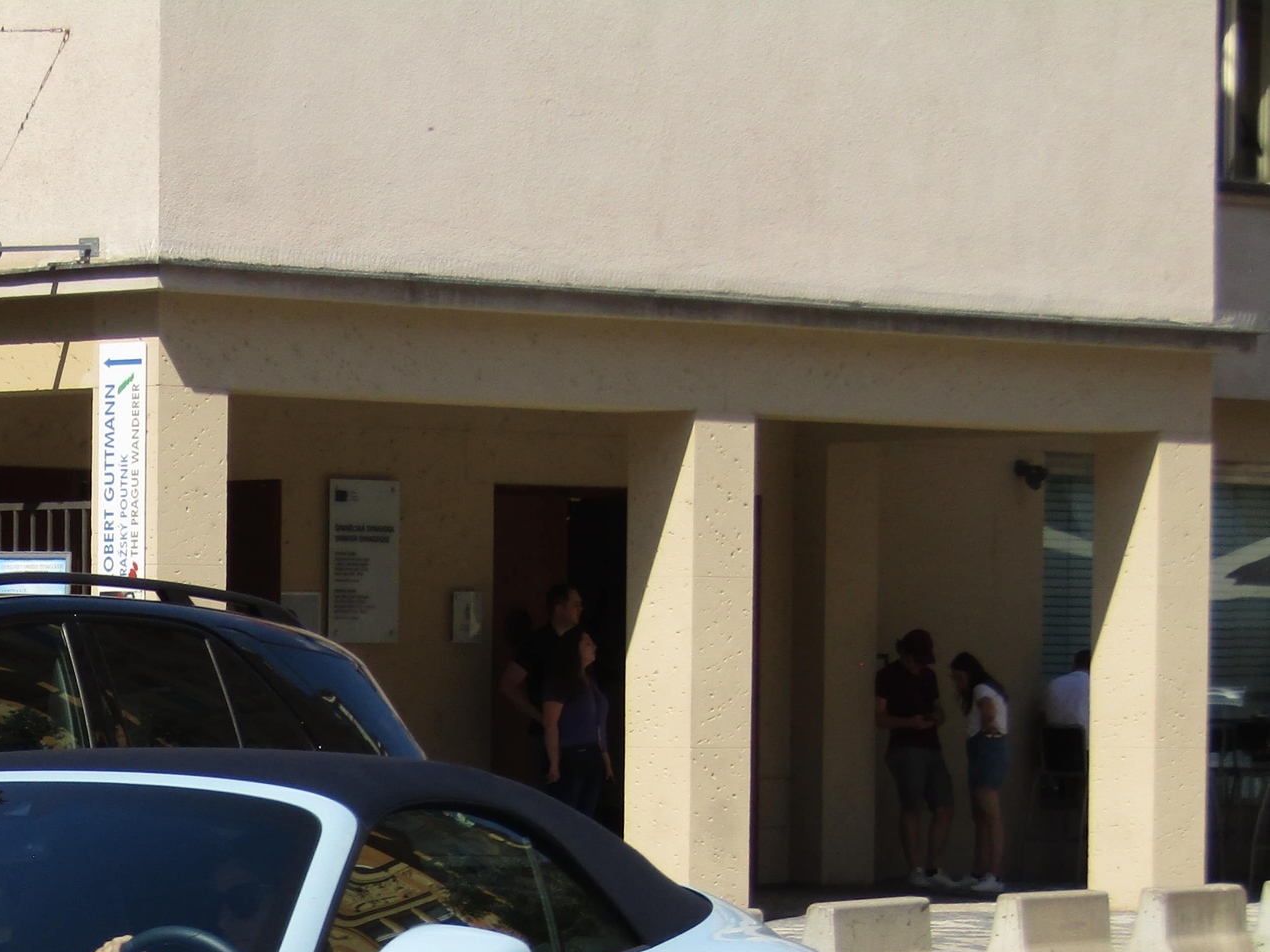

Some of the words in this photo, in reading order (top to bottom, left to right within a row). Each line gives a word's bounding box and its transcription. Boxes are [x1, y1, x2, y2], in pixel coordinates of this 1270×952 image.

[103, 384, 116, 502] GUTTMANN
[130, 383, 141, 465] WANDERER
[118, 453, 129, 518] POUTNÍK
[130, 469, 140, 526] PRAGUE
[103, 509, 115, 575] OBERT
[130, 530, 139, 557] THE
